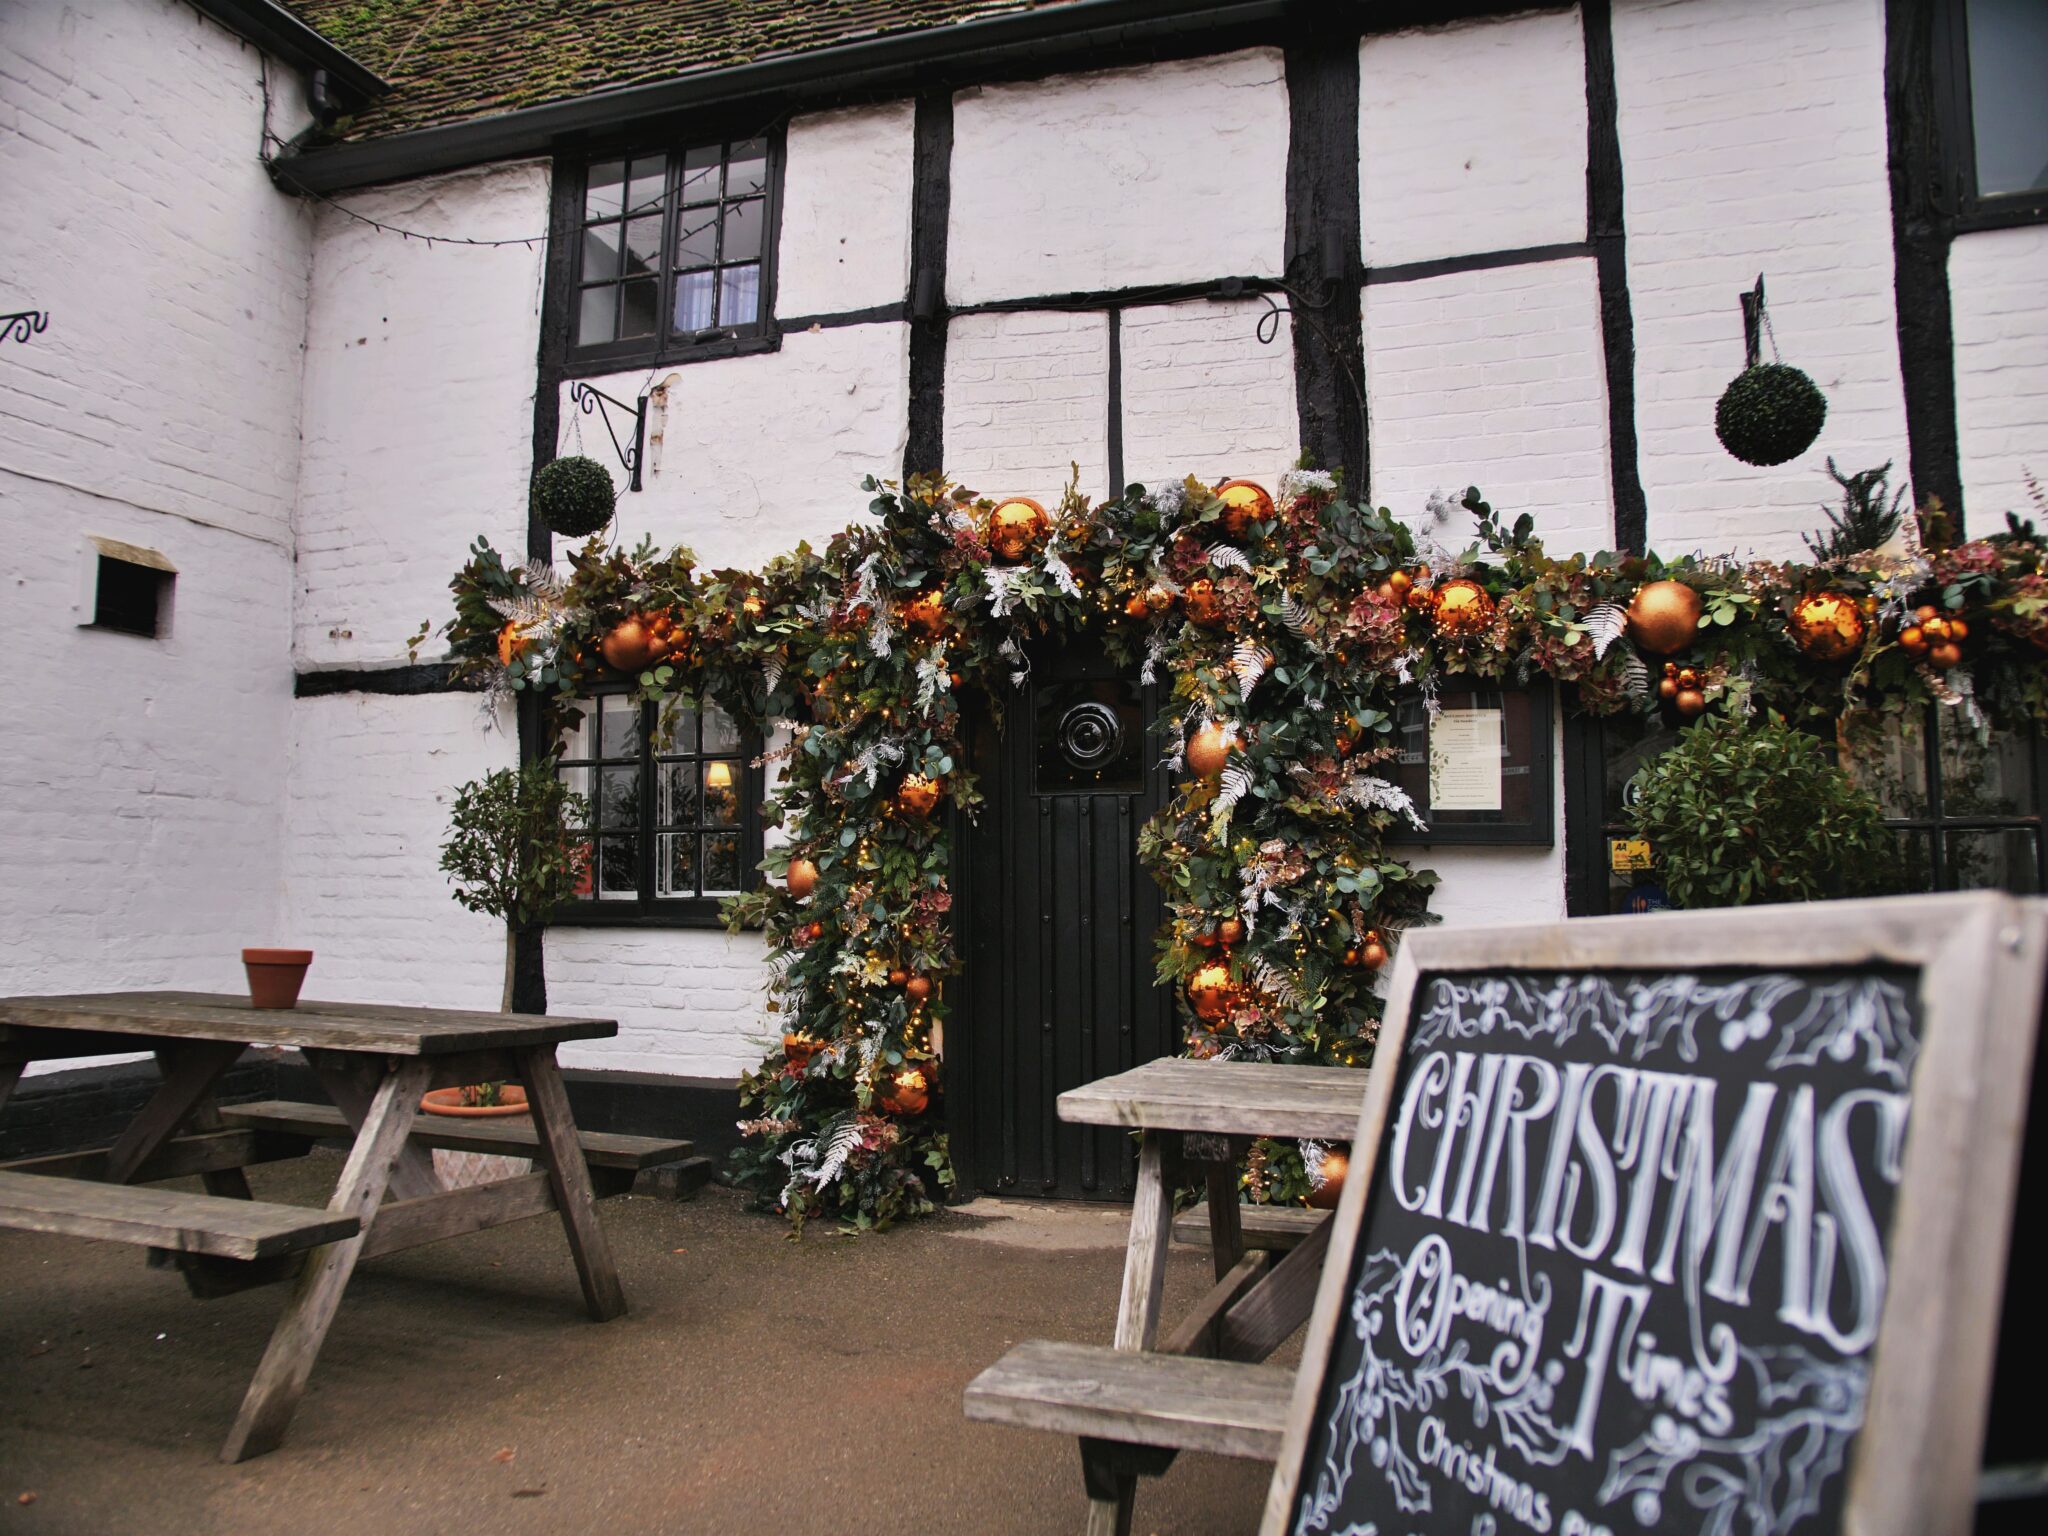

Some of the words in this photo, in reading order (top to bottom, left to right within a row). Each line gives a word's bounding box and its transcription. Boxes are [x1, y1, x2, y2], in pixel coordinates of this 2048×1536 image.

[1615, 843, 1627, 851] AA
[1390, 1050, 1910, 1383] CHRISTMAS
[1395, 1233, 1544, 1395] Opening
[1562, 1268, 1735, 1460] Times
[1417, 1415, 1552, 1533] Christmas
